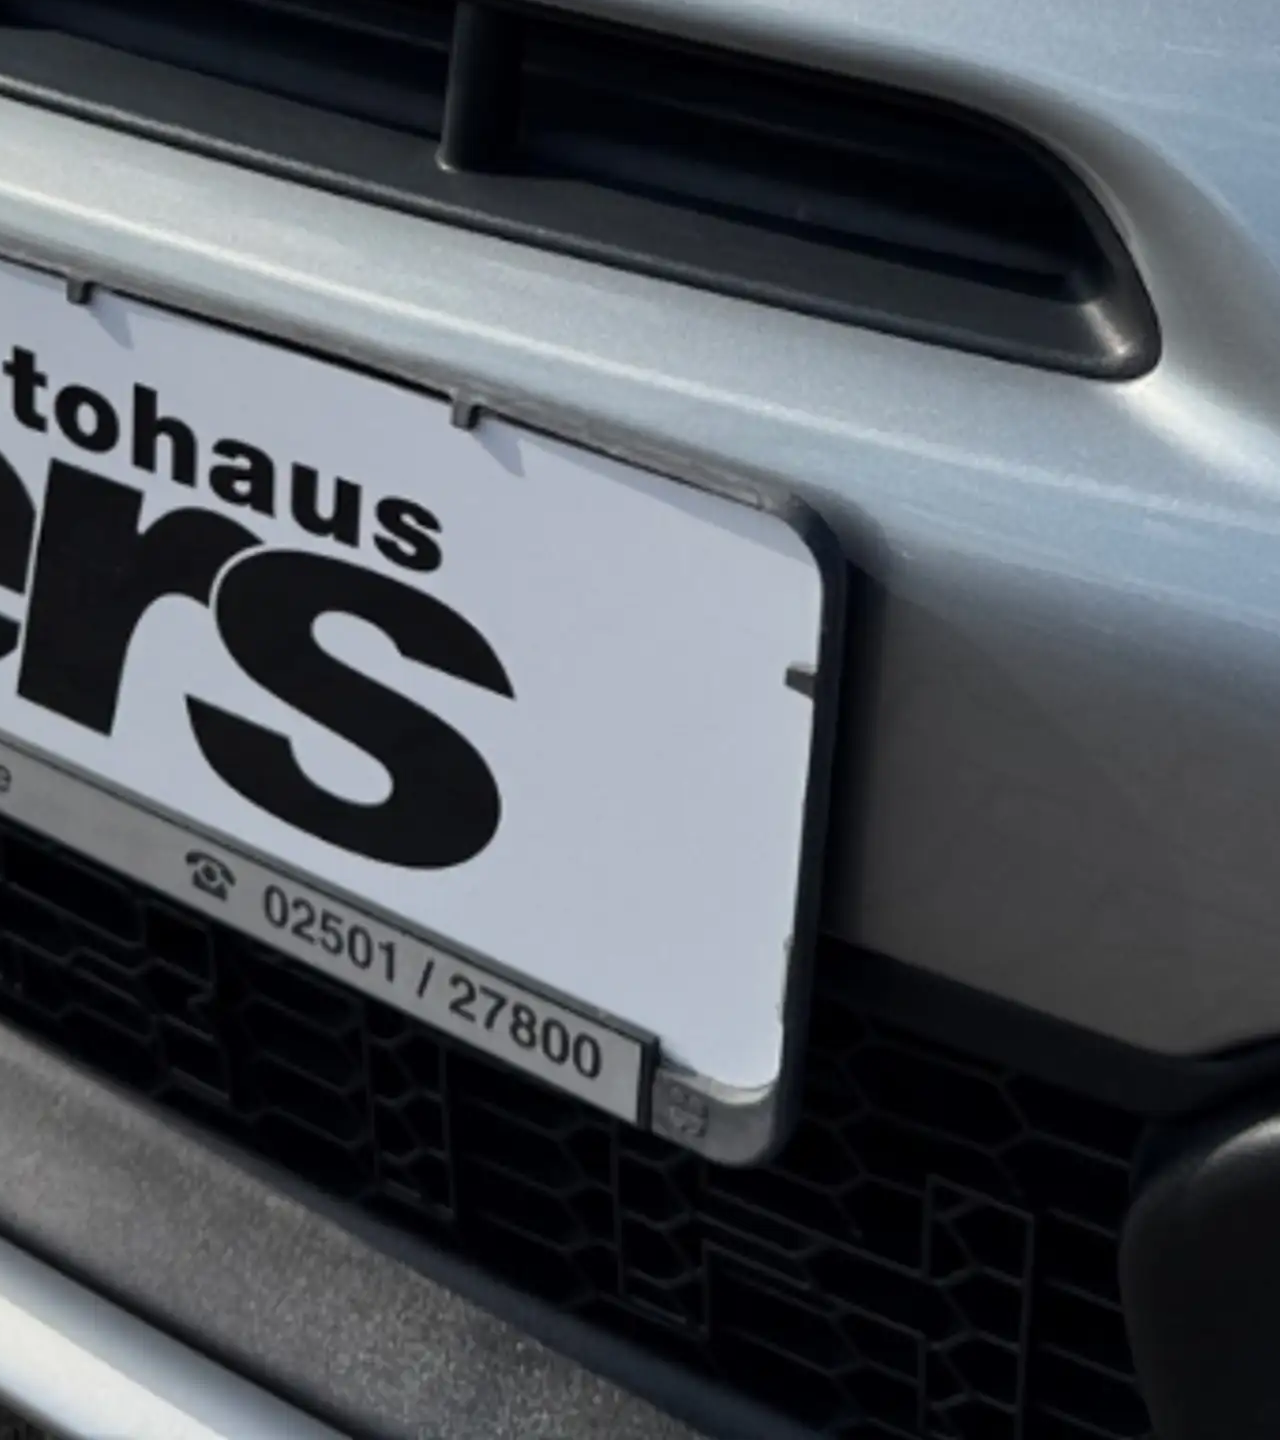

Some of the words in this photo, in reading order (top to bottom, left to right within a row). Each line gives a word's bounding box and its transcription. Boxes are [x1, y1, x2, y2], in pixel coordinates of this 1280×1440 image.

[262, 884, 398, 984] 02501
[416, 959, 434, 998] /
[448, 972, 603, 1081] 27800
